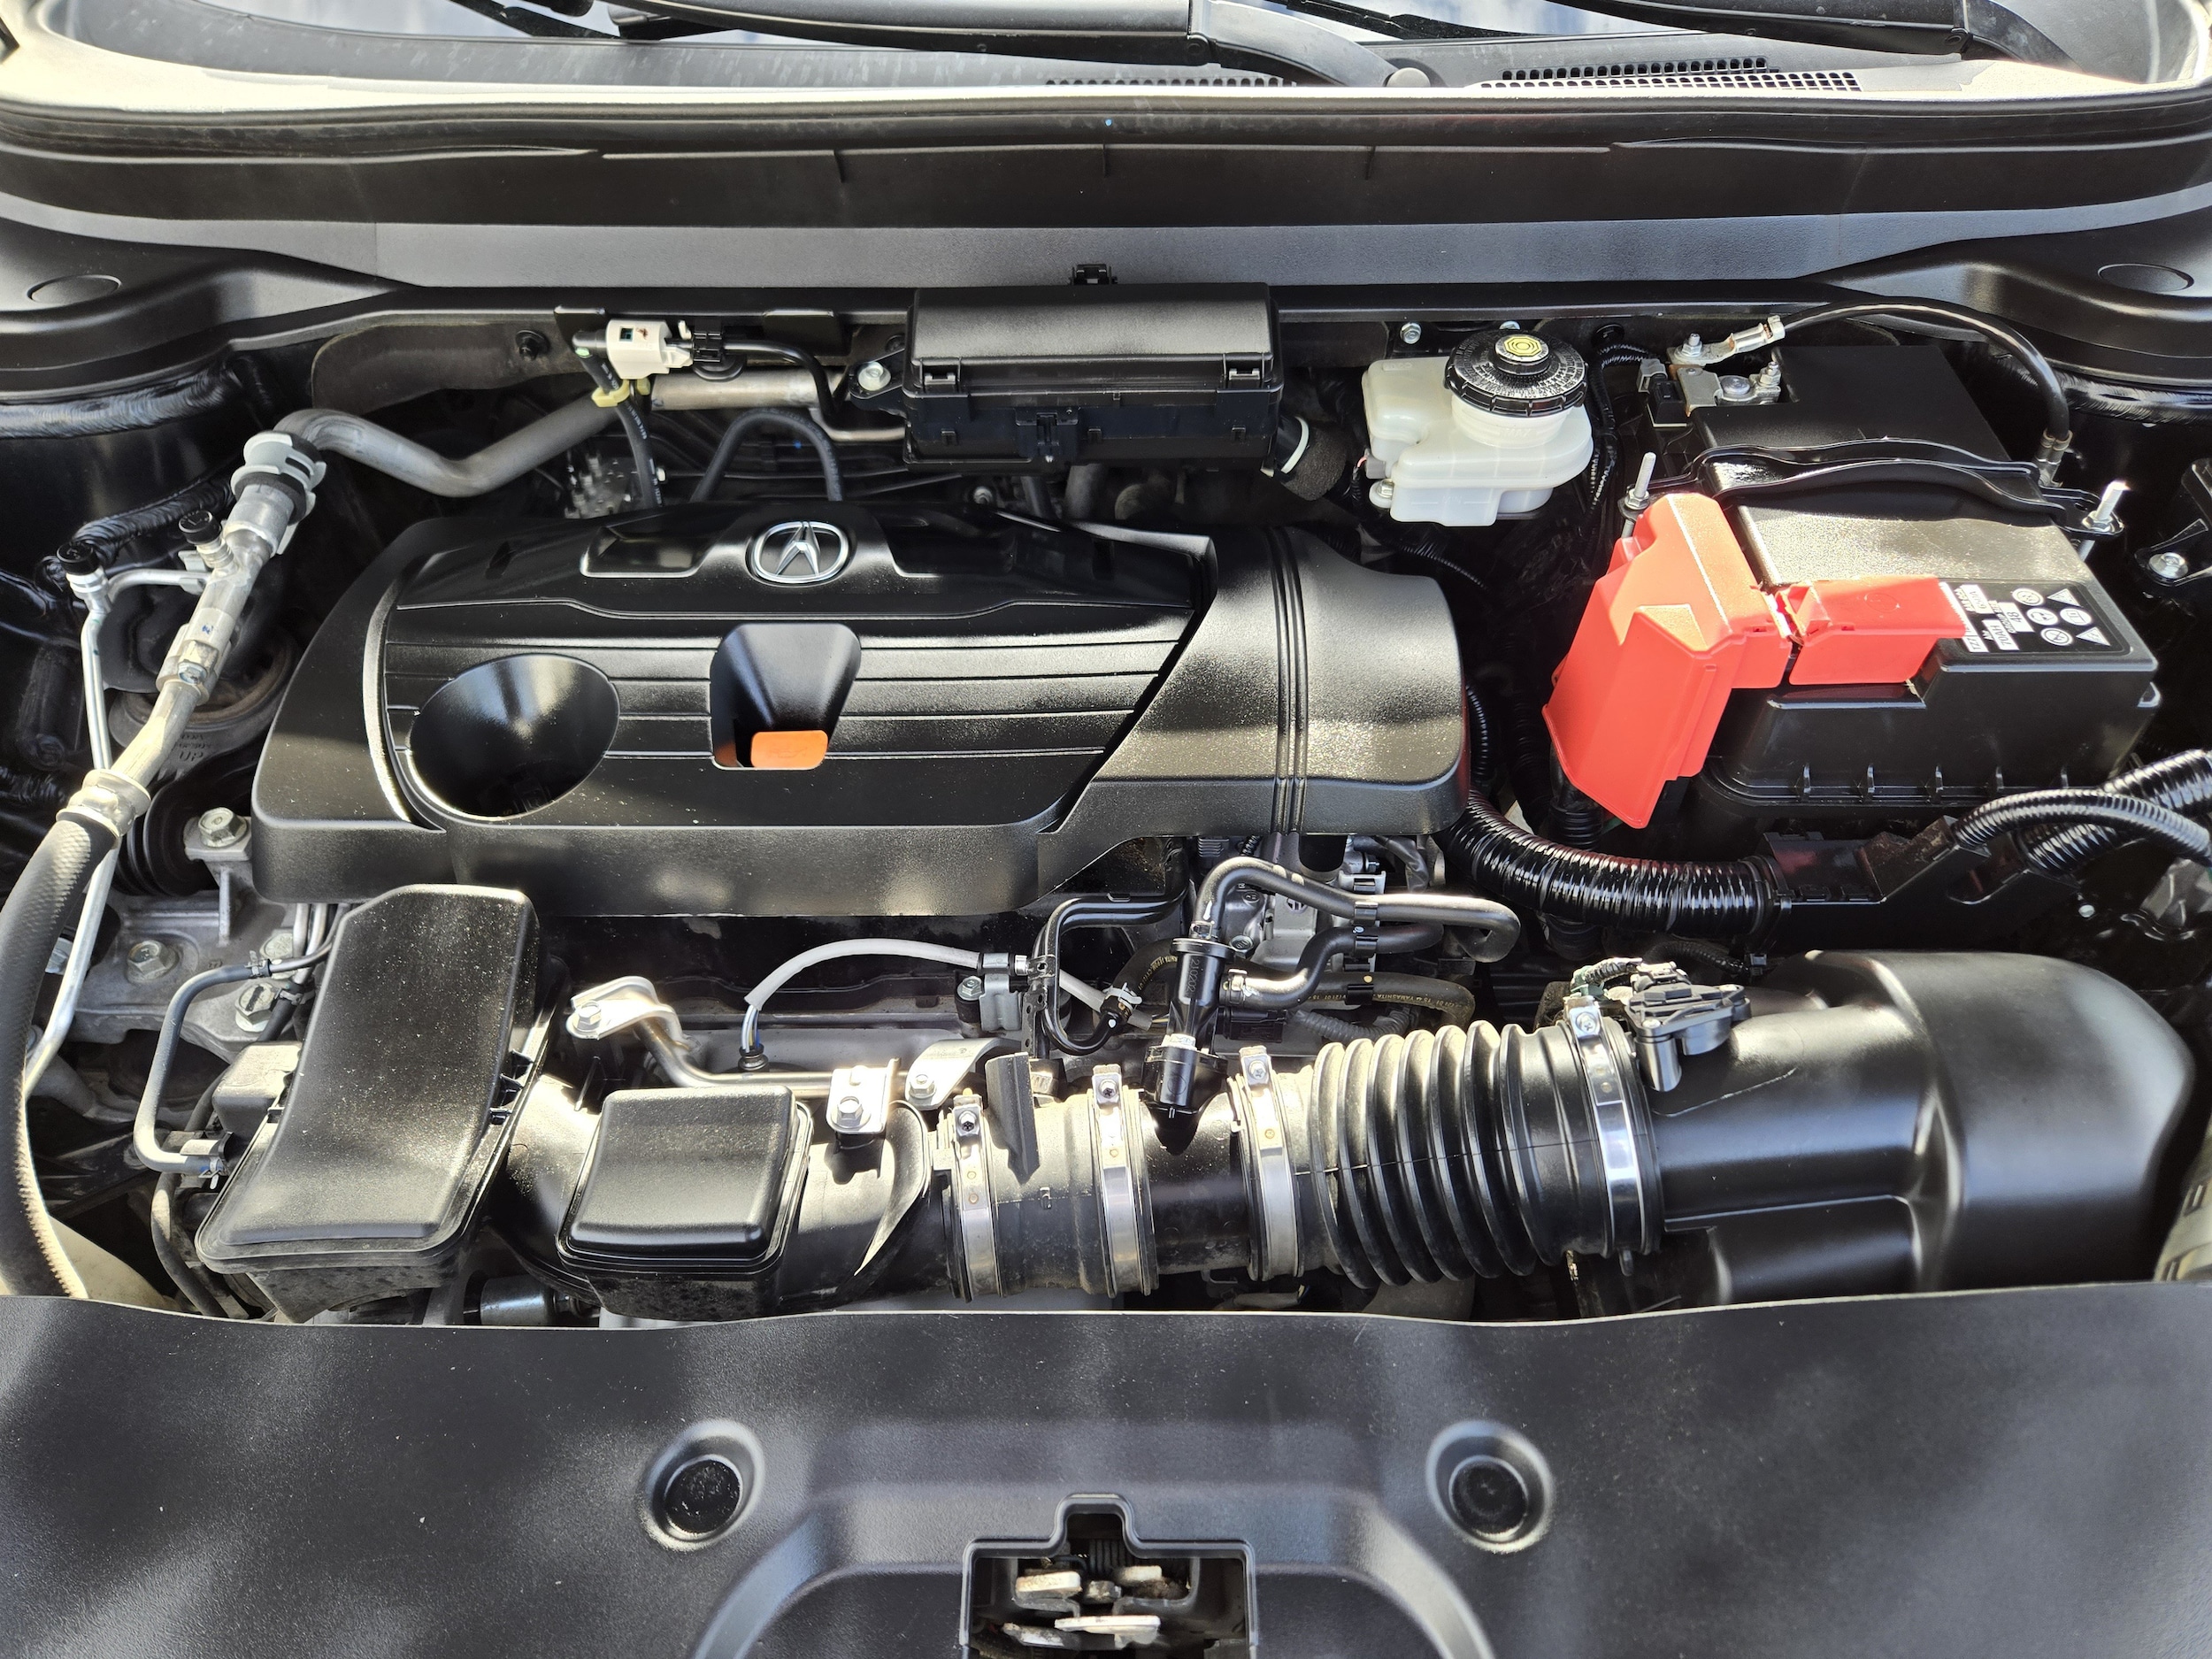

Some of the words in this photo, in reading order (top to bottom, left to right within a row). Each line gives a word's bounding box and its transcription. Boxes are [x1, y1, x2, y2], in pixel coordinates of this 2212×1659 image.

[1996, 612, 2017, 634] GROUP
[2006, 611, 2024, 623] 48
[1989, 625, 2012, 646] 70AH
